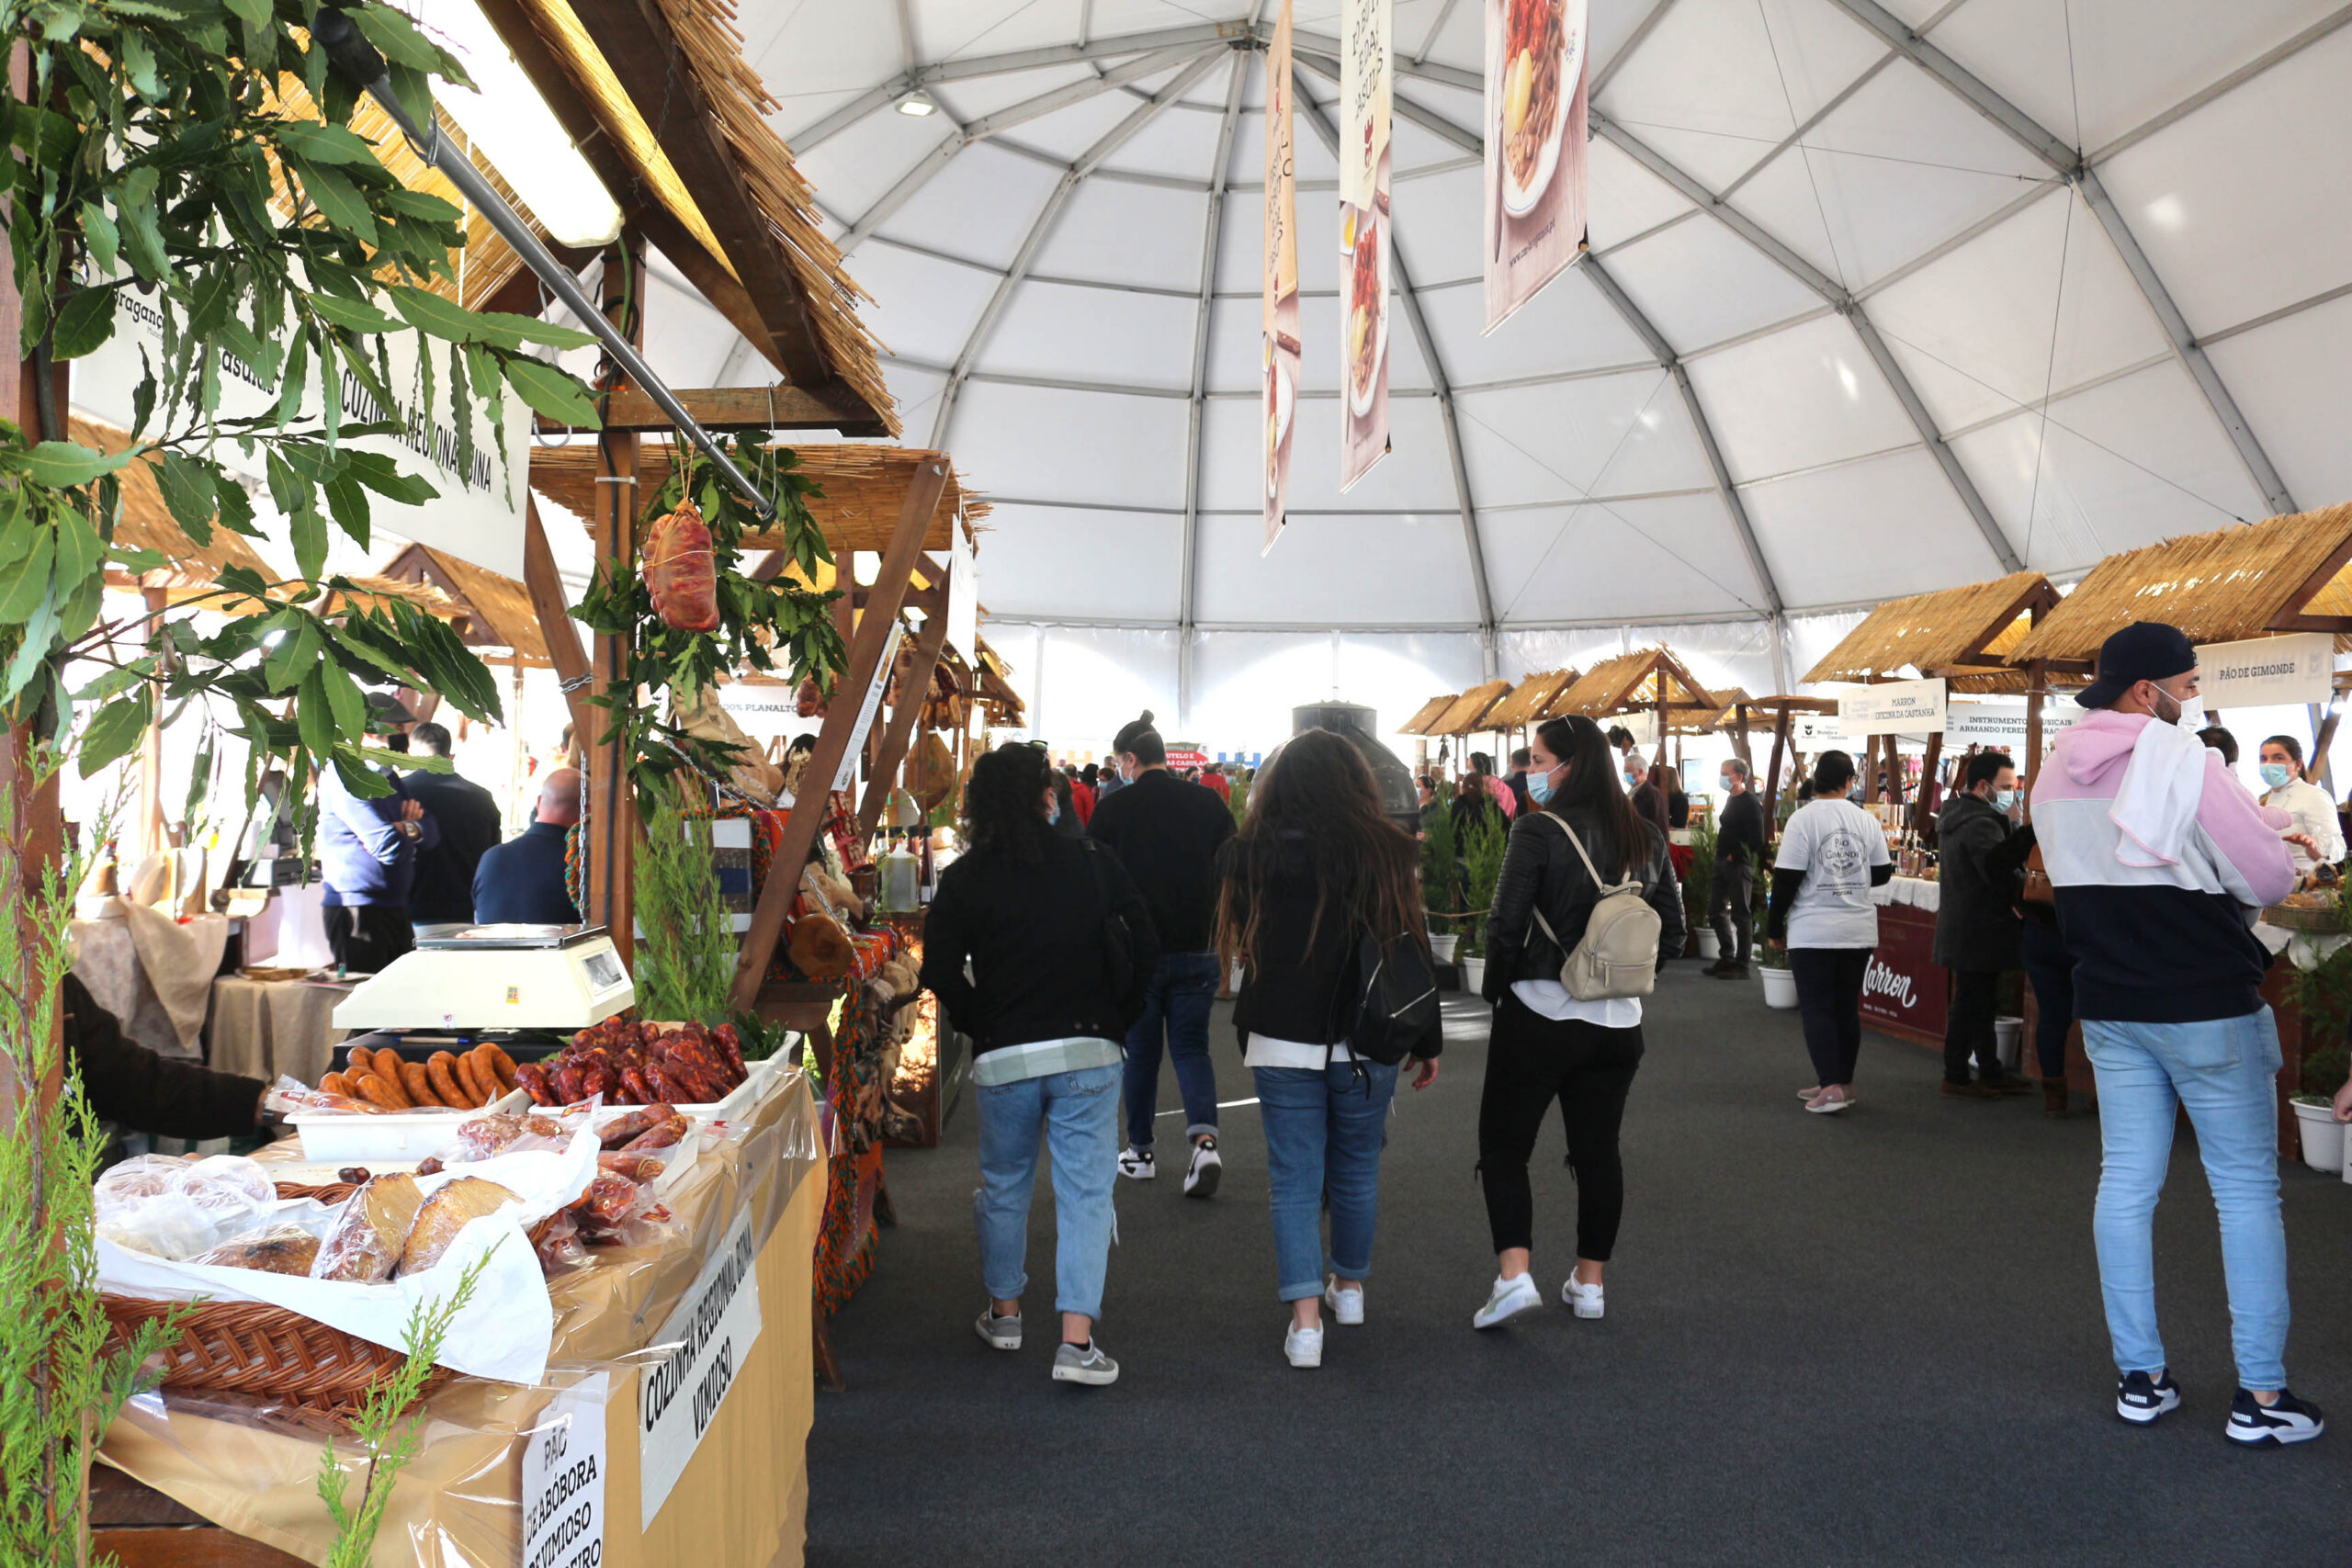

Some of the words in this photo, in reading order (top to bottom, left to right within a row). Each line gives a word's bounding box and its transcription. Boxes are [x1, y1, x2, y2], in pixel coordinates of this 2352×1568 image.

[113, 288, 163, 329] raganç
[341, 367, 405, 443] COZINA
[2220, 667, 2236, 680] PÃO
[2238, 668, 2249, 678] DE
[2251, 662, 2295, 677] GIMONDE
[1892, 696, 1916, 706] MARRON
[1905, 707, 1935, 717] CASTANHA
[1969, 716, 2028, 726] INSTRUMENTO
[1959, 725, 2000, 734] ARMANDO
[646, 1316, 696, 1433] COZINHA
[693, 1335, 732, 1439] VIMIOSO
[2125, 1393, 2147, 1404] PUMA
[2232, 1411, 2252, 1424] PUMA
[538, 1453, 597, 1529] ABÓBORA
[541, 1501, 592, 1568] VIMIOSO
